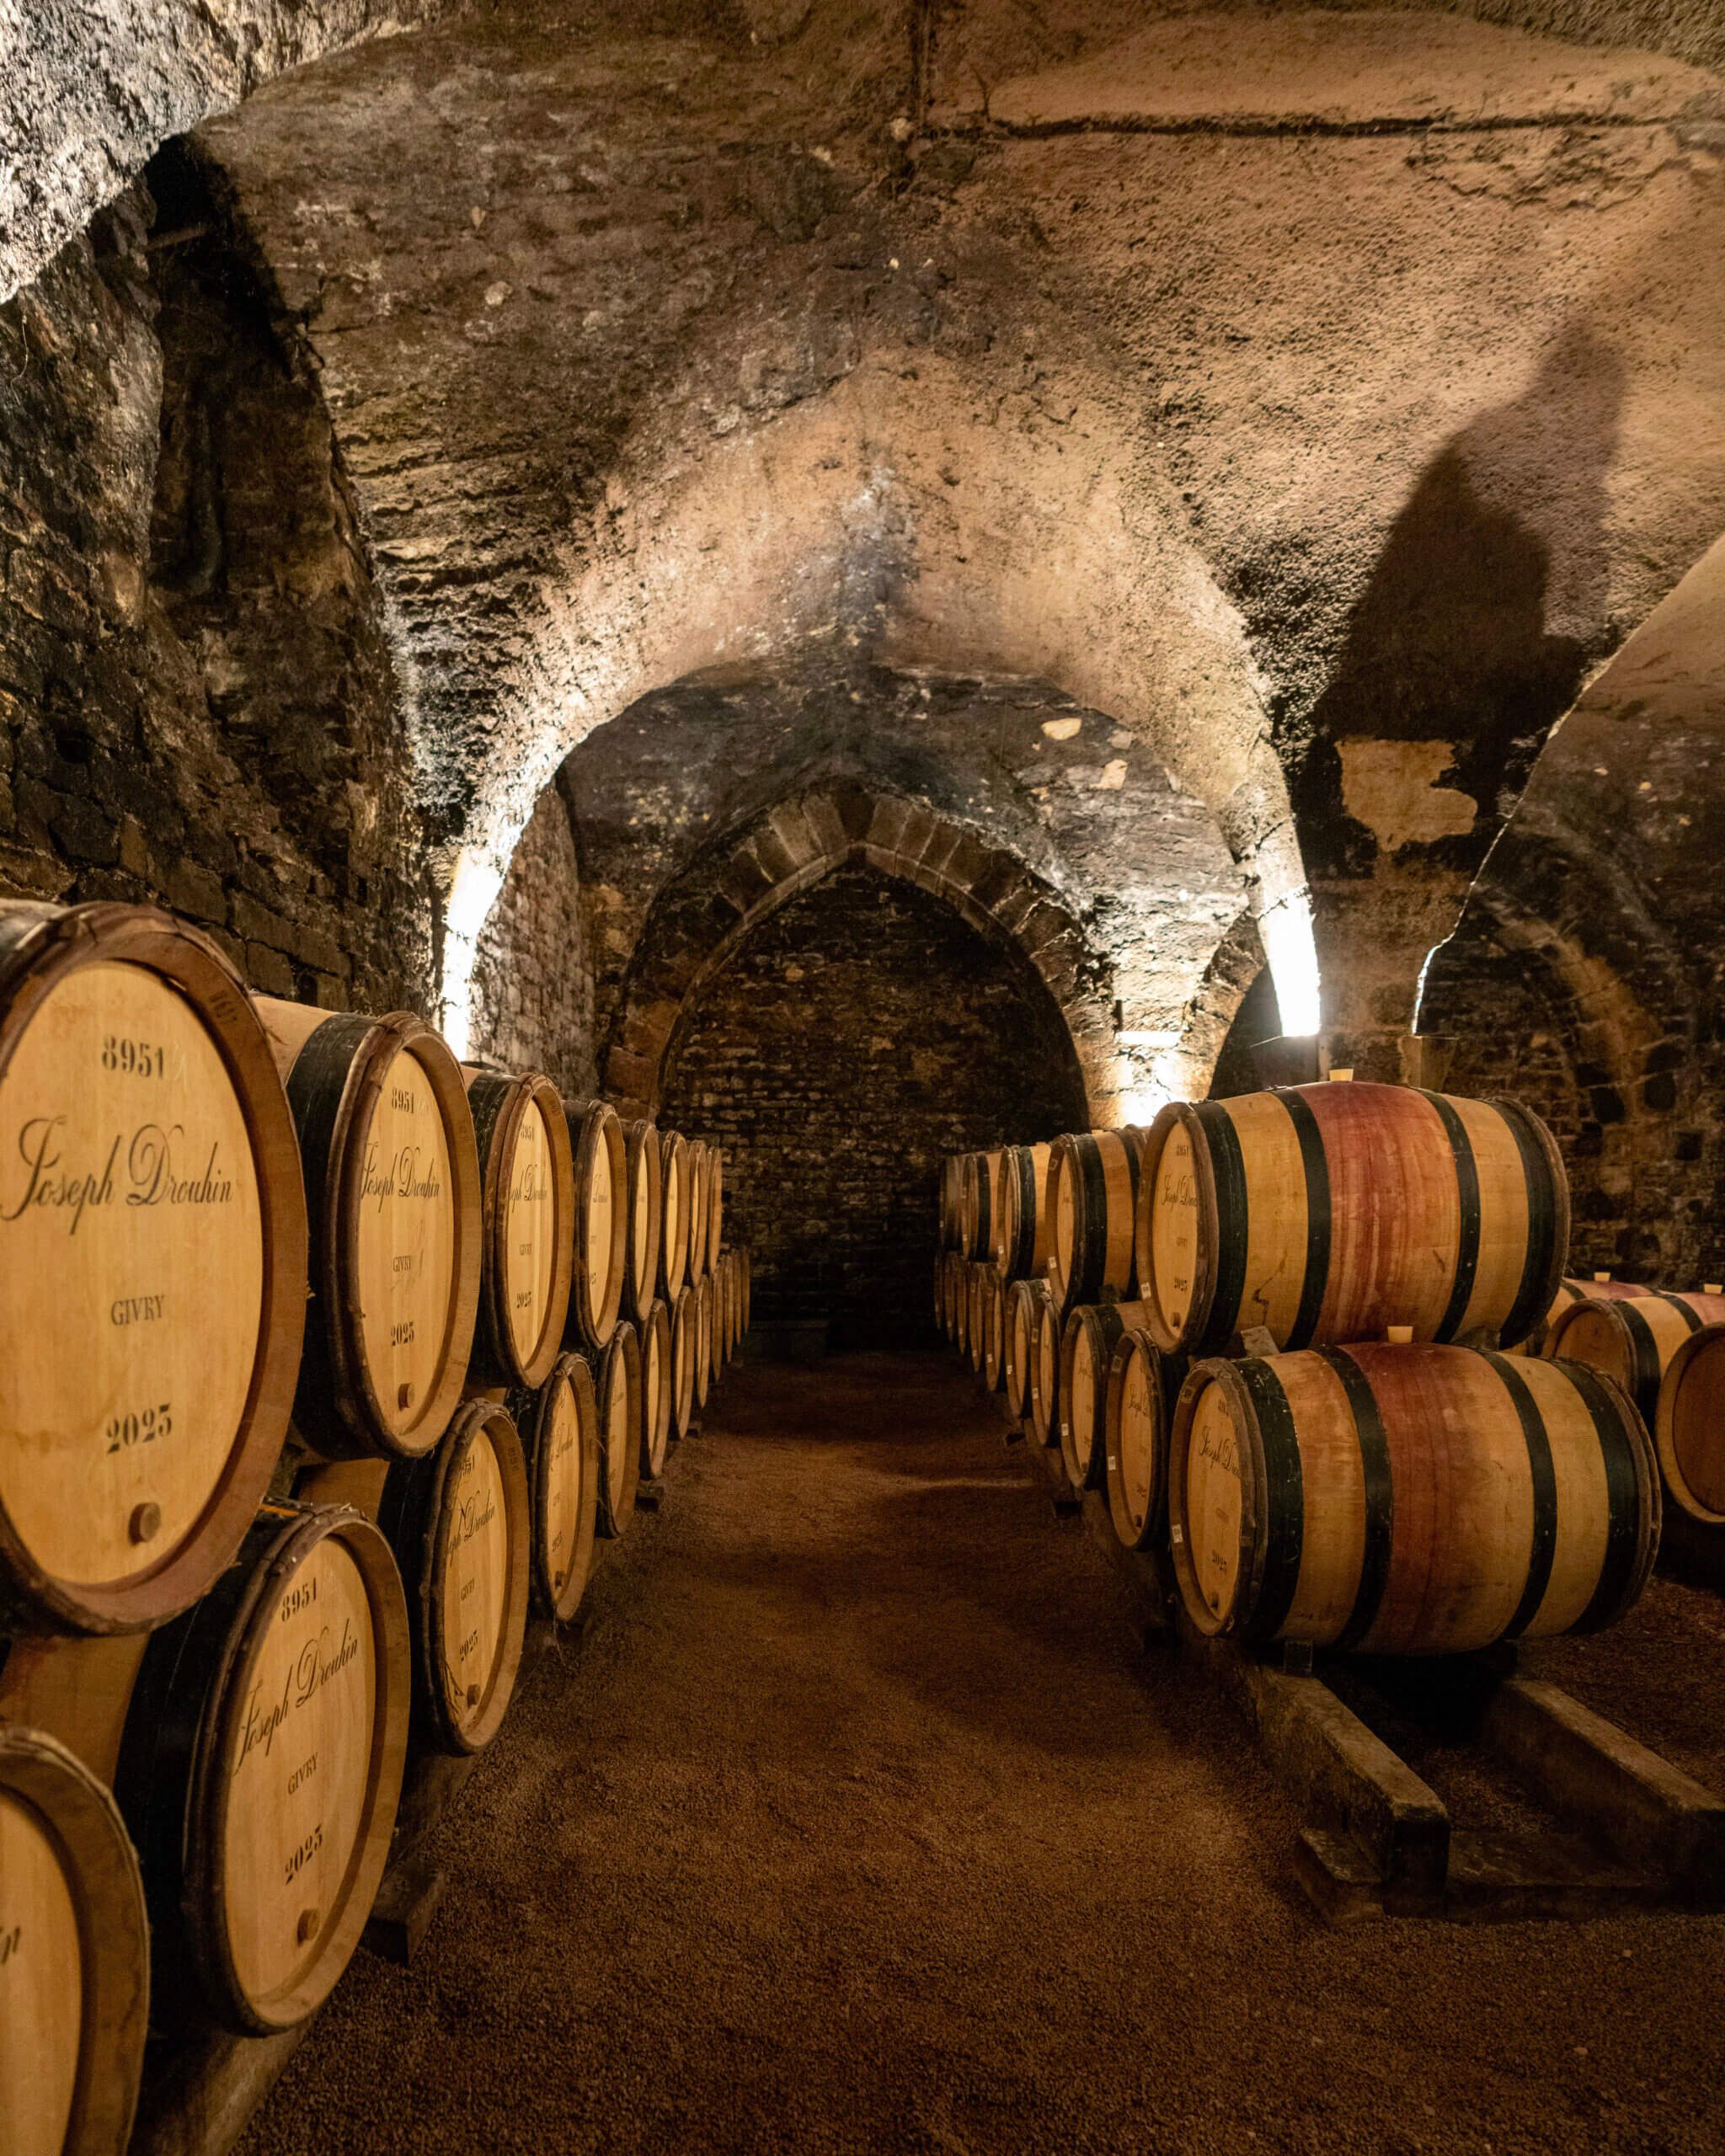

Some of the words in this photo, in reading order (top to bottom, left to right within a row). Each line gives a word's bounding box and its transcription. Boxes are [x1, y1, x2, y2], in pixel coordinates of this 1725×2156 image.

[101, 1033, 164, 1078] 8951
[391, 1087, 414, 1114] 8951
[0, 1115, 121, 1235] Joseph
[126, 1123, 232, 1207] Drouhin
[361, 1140, 398, 1214] Joseph
[398, 1146, 441, 1199] Drouhin
[393, 1255, 412, 1273] GIVRY
[110, 1294, 165, 1326] GIVRY
[390, 1321, 414, 1347] 2025
[106, 1402, 173, 1454] 2025
[280, 1577, 317, 1623] 8951
[232, 1663, 294, 1778] Joseph
[296, 1617, 358, 1709] Drouhin
[287, 1751, 318, 1796] GIVRY
[285, 1822, 323, 1886] 2025
